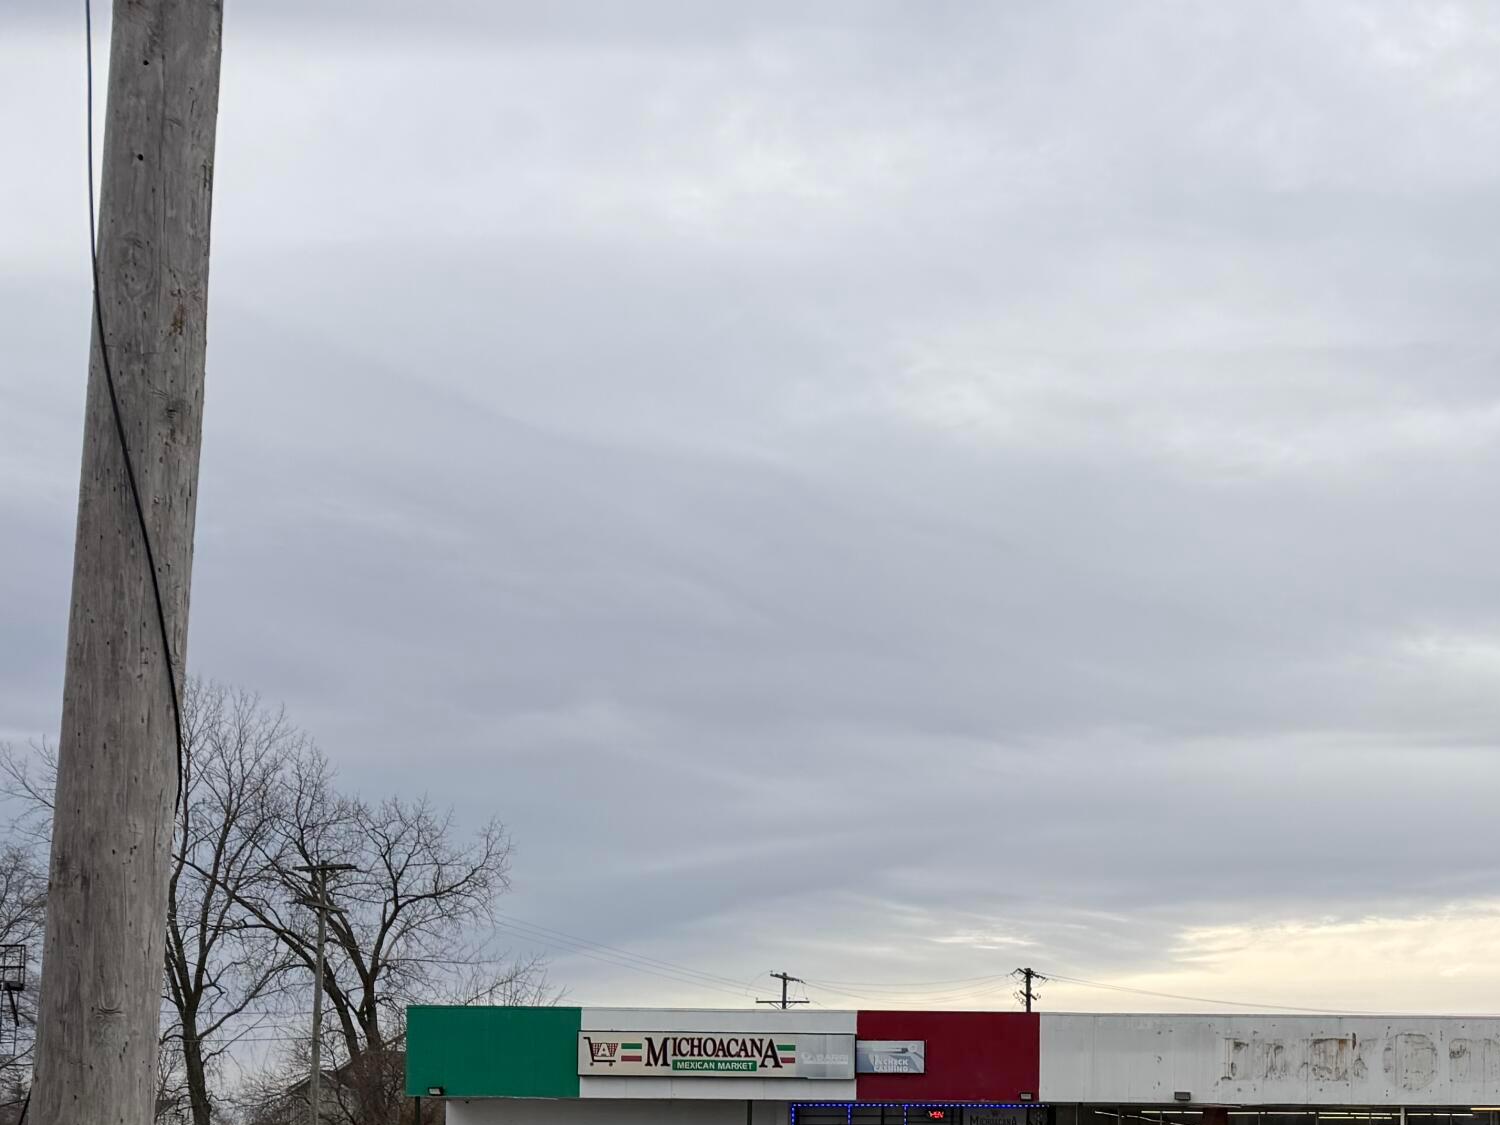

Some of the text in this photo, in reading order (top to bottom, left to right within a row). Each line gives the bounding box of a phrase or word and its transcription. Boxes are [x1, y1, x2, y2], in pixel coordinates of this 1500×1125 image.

[645, 1037, 783, 1068] MICHOACANA
[677, 1061, 754, 1071] MEXICAN MARKET
